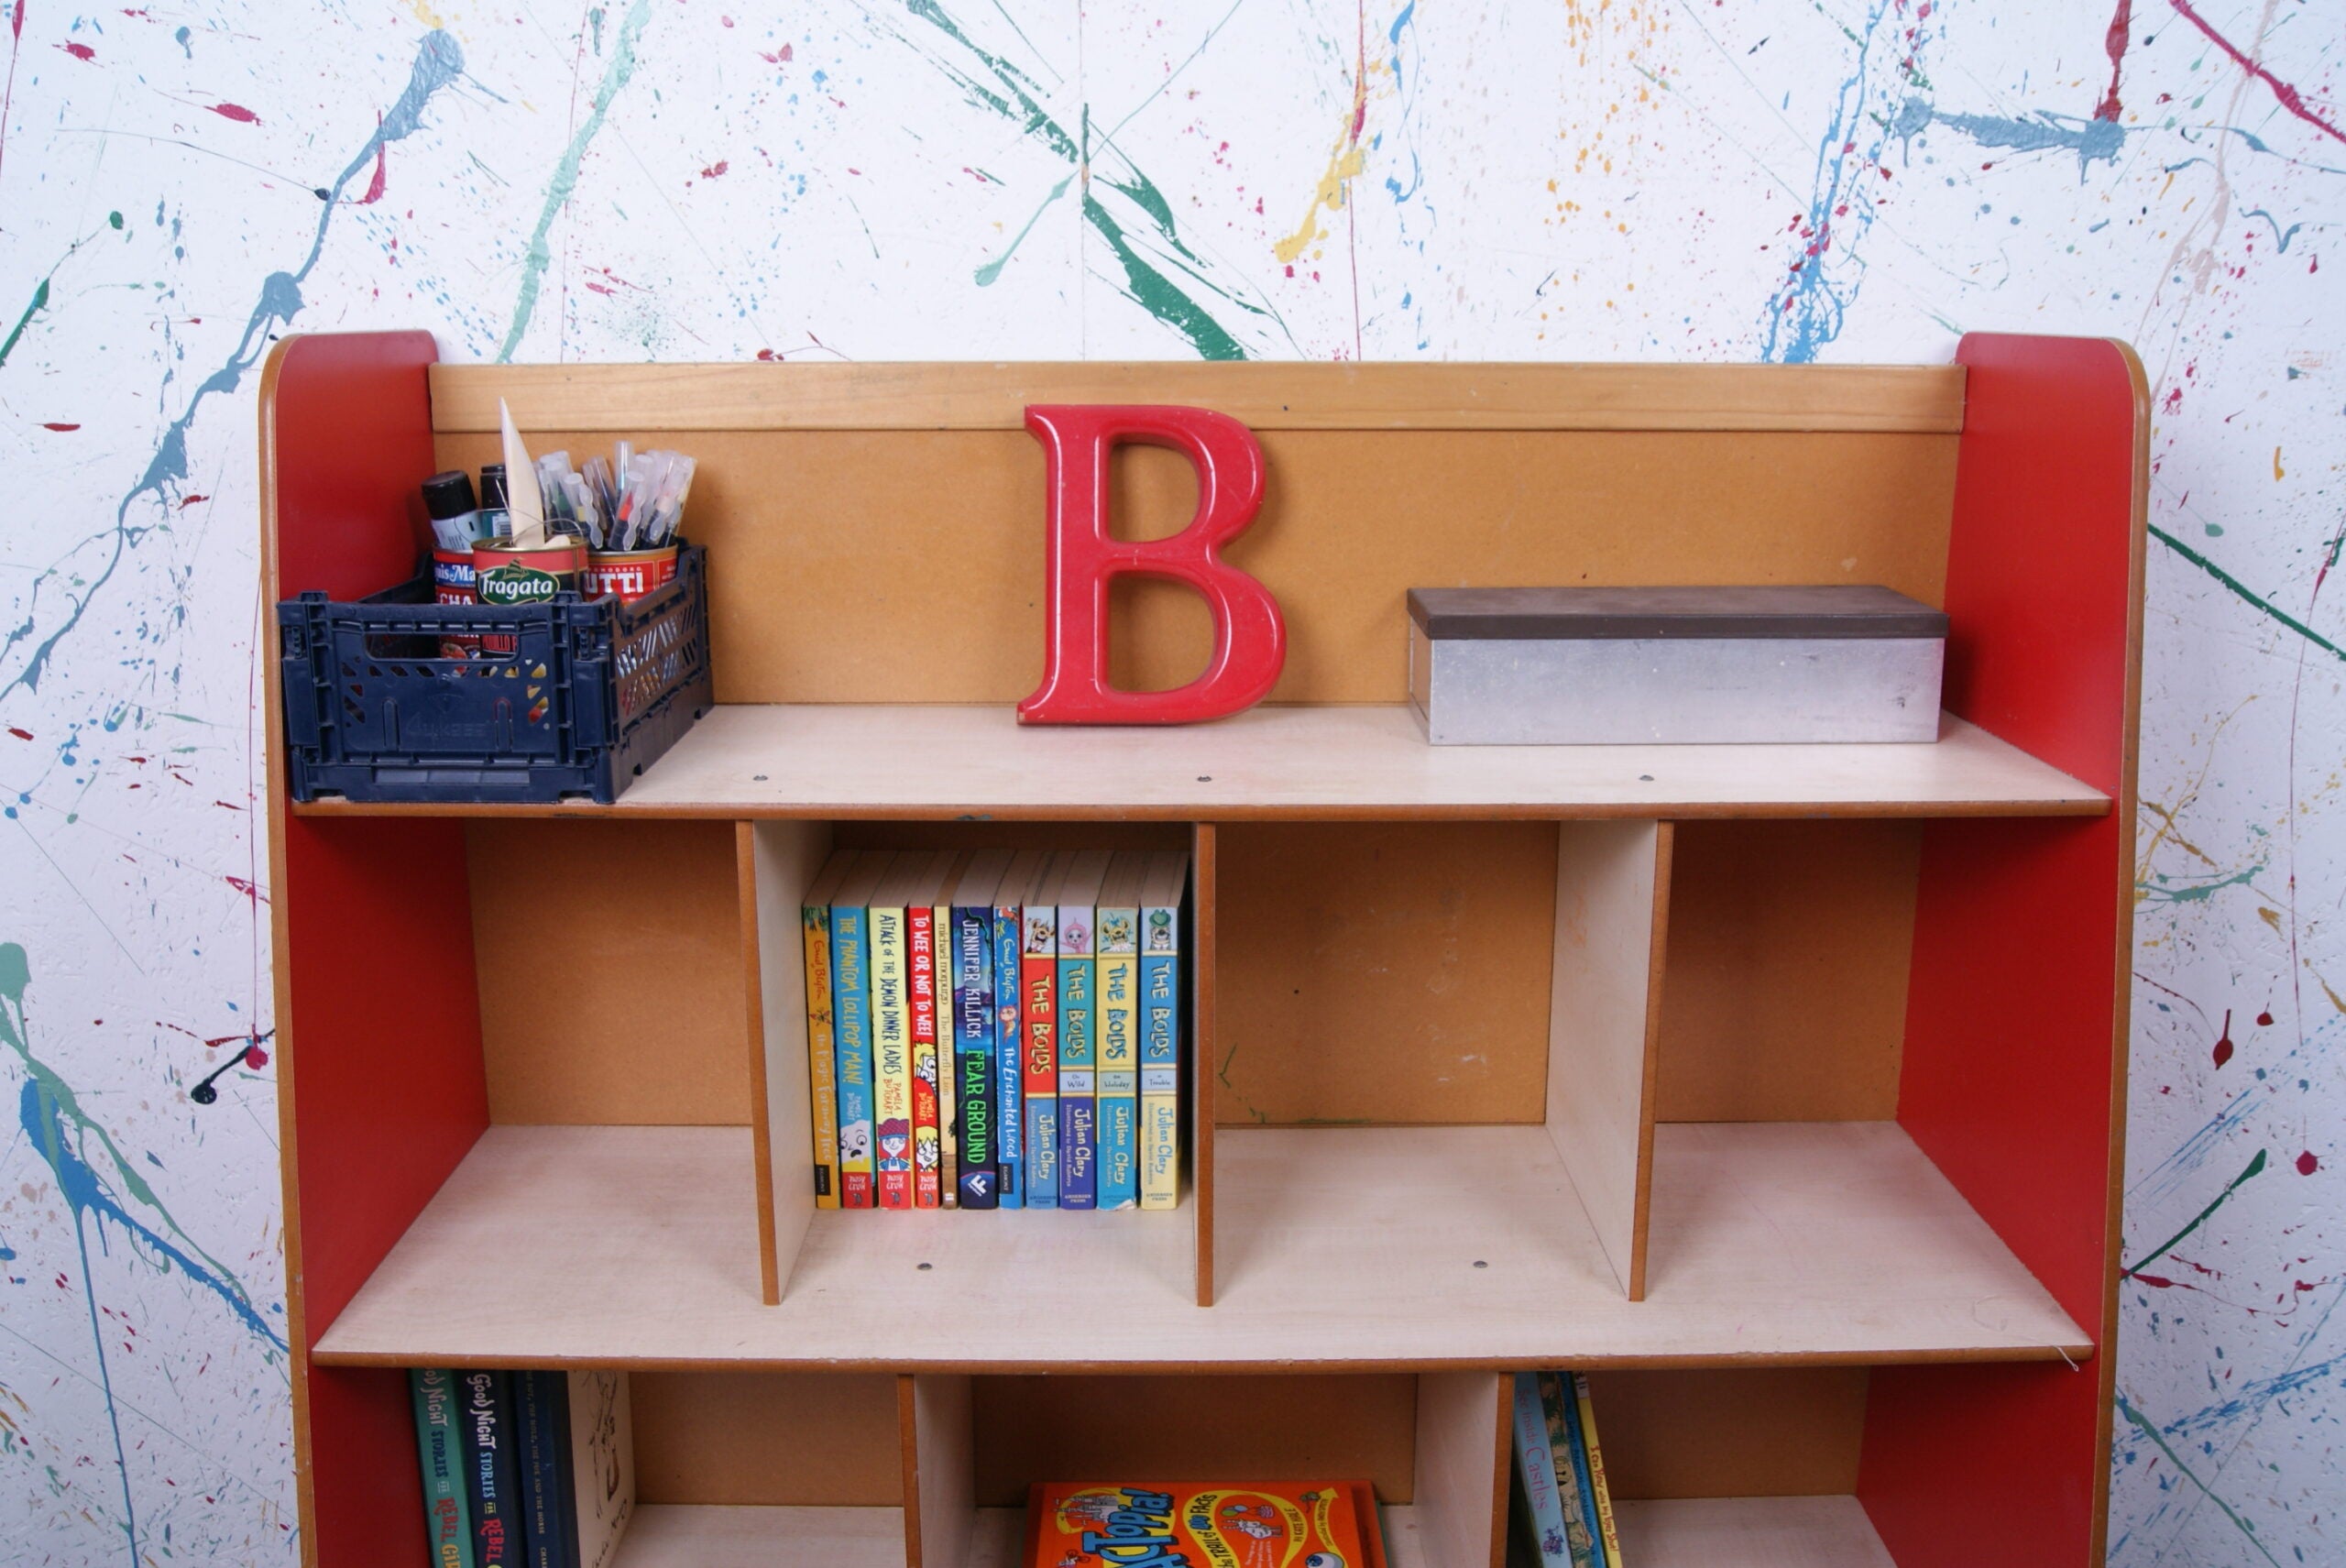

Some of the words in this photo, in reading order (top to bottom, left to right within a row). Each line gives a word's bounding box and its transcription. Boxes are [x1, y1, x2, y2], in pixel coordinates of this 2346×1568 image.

[1017, 404, 1287, 725] B
[584, 572, 644, 594] UTTI
[839, 916, 857, 935] THE
[880, 915, 896, 945] ATTACK
[914, 915, 930, 927] TO
[814, 940, 825, 965] Enid
[914, 930, 931, 953] WEE
[938, 923, 949, 959] michael
[962, 919, 981, 981] JENNIFER
[1003, 938, 1015, 964] Enid
[838, 938, 861, 992] PHANTOM
[882, 961, 894, 974] THE
[915, 955, 931, 971] OR
[880, 978, 899, 1007] DEMON
[915, 974, 931, 996] NOT
[938, 961, 950, 1005] morpurgo
[1002, 968, 1015, 1001] Blyton
[1030, 975, 1052, 1014] THE
[1067, 965, 1087, 1002] THE
[1107, 962, 1129, 1002] THE
[1151, 961, 1172, 1000] THE
[916, 999, 932, 1011] TO
[965, 988, 981, 1038] KILLICK
[842, 997, 861, 1047] LOLLIPOP
[882, 1011, 901, 1041] DINNER
[915, 1014, 933, 1036] WEE!
[941, 1014, 949, 1032] The
[1065, 1009, 1088, 1058] BOLDS
[1105, 1009, 1129, 1059] BOLDS
[1149, 1007, 1172, 1058] BOLDS
[882, 1045, 902, 1075] LADIES
[940, 1035, 952, 1073] Butterfly
[1004, 1047, 1016, 1066] The
[1029, 1023, 1052, 1075] BOLDS
[817, 1050, 830, 1083] Magic
[842, 1050, 863, 1085] MAN!
[965, 1049, 986, 1096] FEAR
[883, 1078, 893, 1115] BUTCHART
[893, 1082, 902, 1111] PAMELA
[943, 1076, 951, 1096] Lion
[1003, 1068, 1017, 1126] Enchanted
[1068, 1080, 1085, 1088] Wild
[917, 1091, 927, 1122] BUTCHART
[966, 1100, 987, 1164] GROUND
[1038, 1114, 1056, 1148] Julian
[1074, 1108, 1092, 1145] Julian
[1114, 1106, 1130, 1146] Julian
[1157, 1107, 1174, 1142] Julian
[820, 1137, 833, 1161] Tree
[1005, 1129, 1018, 1158] Wood
[1038, 1151, 1056, 1179] Clary
[1073, 1146, 1091, 1178] Clary
[1113, 1151, 1129, 1184] Clary
[1156, 1145, 1173, 1175] Clary
[431, 1431, 448, 1477] STORIES
[1517, 1387, 1531, 1409] See
[1525, 1446, 1551, 1510] Castles
[479, 1452, 496, 1498] STORIES
[1594, 1467, 1606, 1488] Read
[433, 1497, 459, 1541] REBEL
[486, 1503, 496, 1514] FOR
[1189, 1494, 1218, 1516] FACTS
[1284, 1508, 1300, 1522] HALE
[537, 1511, 545, 1535] HORSE
[1291, 1523, 1304, 1536] KATE
[1603, 1516, 1614, 1532] Eyes
[479, 1518, 505, 1563] REBEL
[1203, 1537, 1231, 1559] TRAIL
[1606, 1532, 1619, 1552] Shut!
